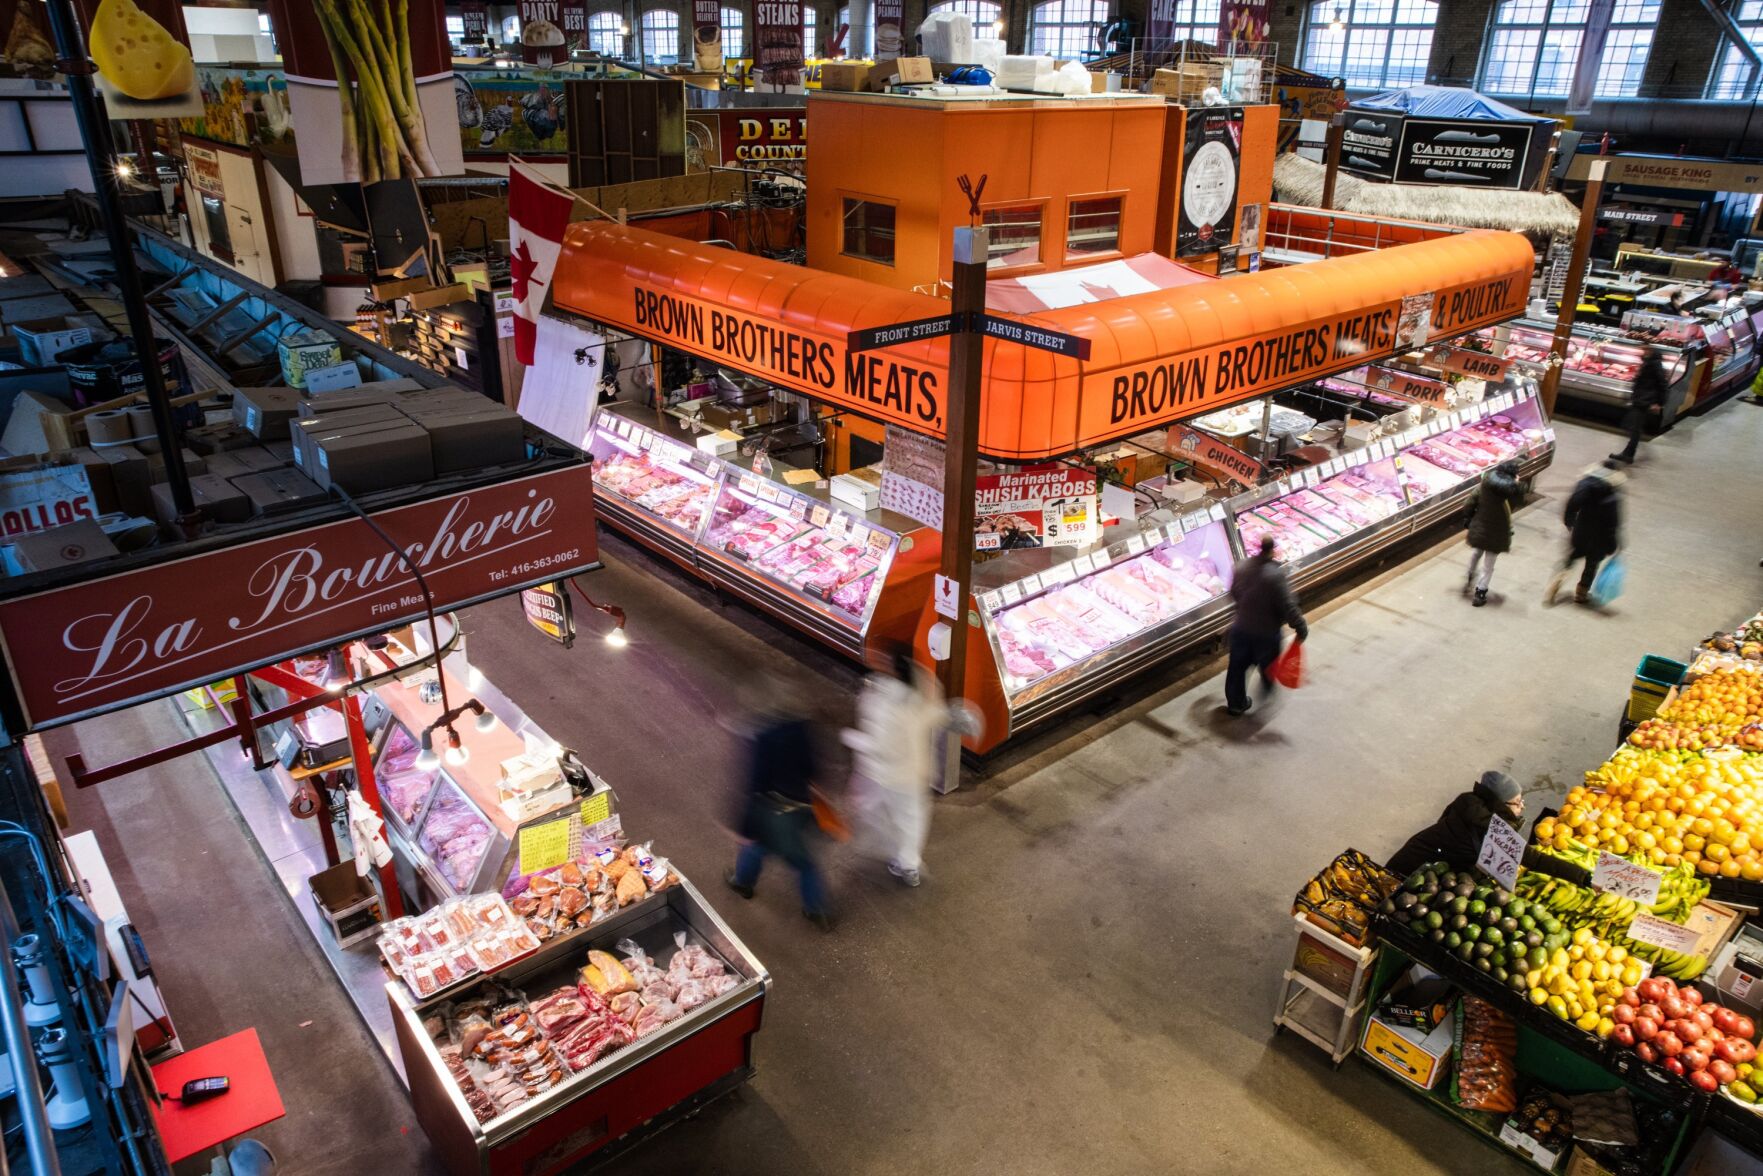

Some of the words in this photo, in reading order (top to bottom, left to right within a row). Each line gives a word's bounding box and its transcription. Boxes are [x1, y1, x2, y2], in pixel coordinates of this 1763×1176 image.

[522, 2, 559, 21] PARTY
[758, 4, 799, 26] STEAKS
[564, 15, 585, 30] BEST
[1412, 142, 1515, 159] CARNICERO'S
[1487, 162, 1512, 170] FOODS
[1624, 164, 1679, 176] SAUSAGE
[1681, 168, 1712, 178] KING
[1603, 210, 1625, 219] MAIN
[1625, 213, 1658, 222] STREET
[875, 328, 909, 344] FRONT
[912, 320, 951, 337] STREET
[986, 321, 1022, 340] JARVIS
[1024, 330, 1066, 350] STREET
[634, 287, 704, 345] BROWN
[711, 310, 836, 389] BROTHERS
[844, 348, 942, 429] MEATS,
[1110, 354, 1209, 425] BROWN
[1215, 324, 1331, 396] BROTHERS
[1433, 295, 1447, 331] &
[1449, 277, 1514, 327] POULTRY
[1463, 357, 1501, 378] LAMB
[1404, 381, 1445, 402] PORK
[1207, 447, 1254, 480] CHICKEN
[1000, 470, 1069, 488] Marinated
[975, 486, 1022, 503] SHISH
[1028, 480, 1096, 500] KABOBS
[1048, 524, 1058, 538] $
[488, 568, 508, 583] Tel:
[511, 548, 580, 576] 416-363-0062
[54, 595, 203, 693] La
[228, 489, 557, 631] Boucherie
[371, 602, 398, 616] Fine
[400, 591, 435, 608] Meas
